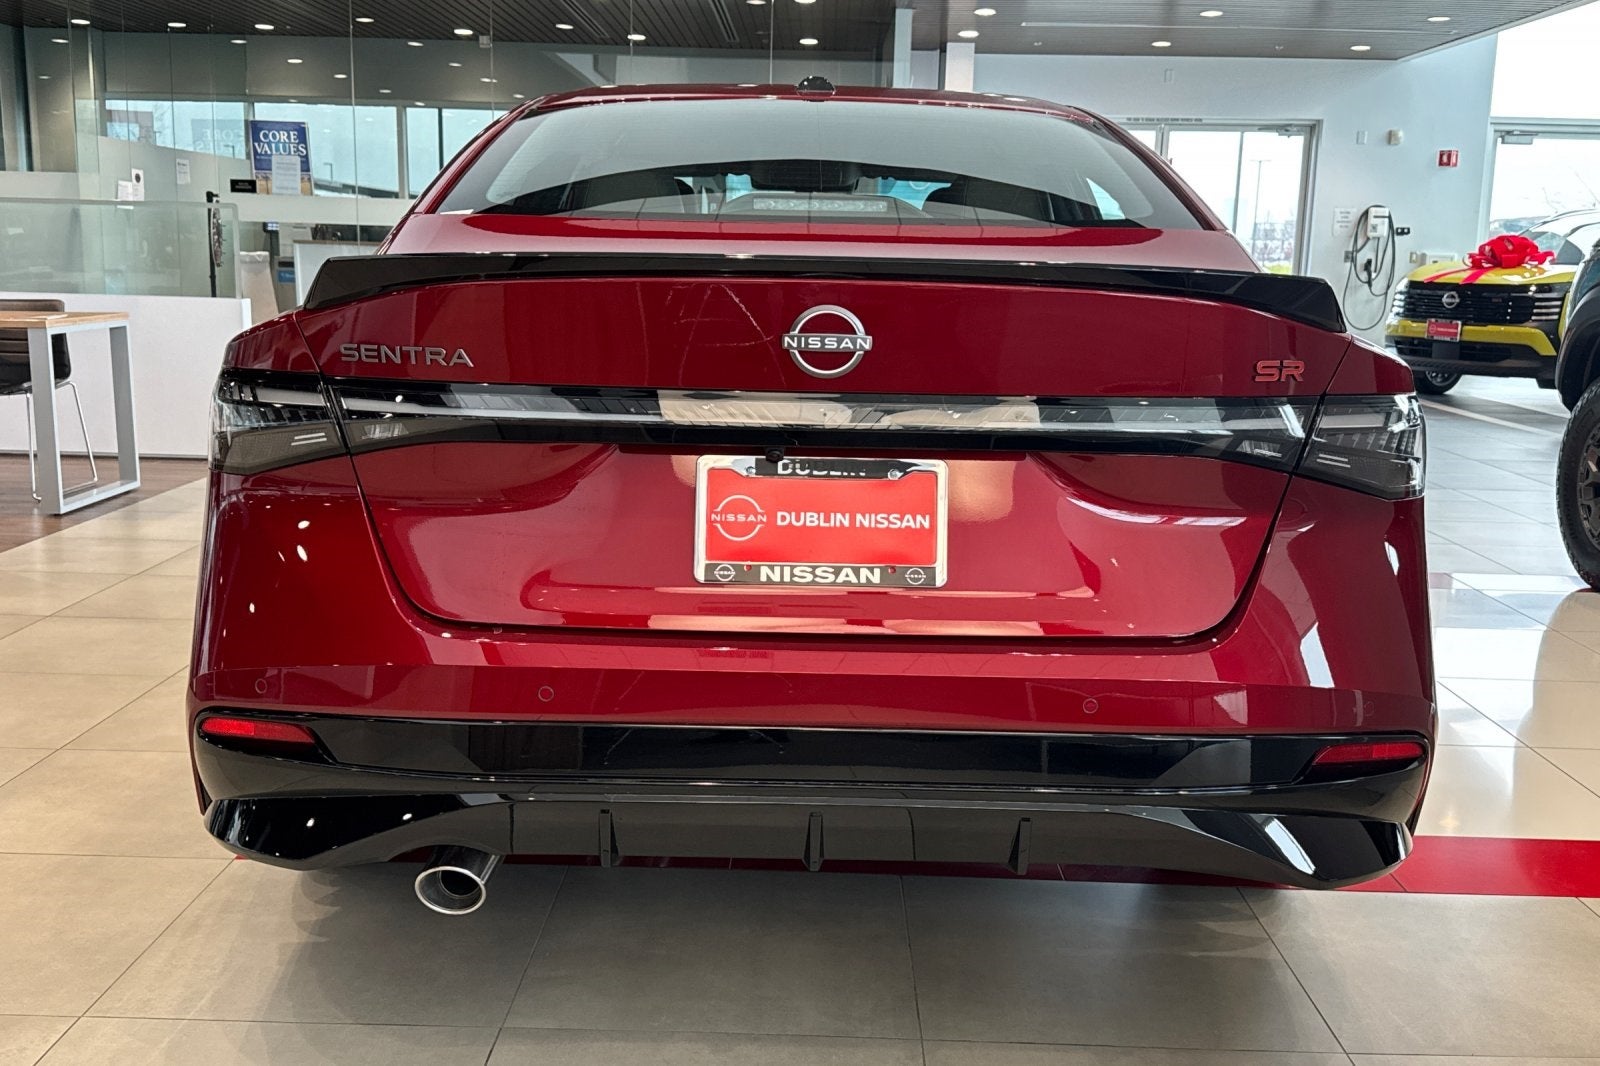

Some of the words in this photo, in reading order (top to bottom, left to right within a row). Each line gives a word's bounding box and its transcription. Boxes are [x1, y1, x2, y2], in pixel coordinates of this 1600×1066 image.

[259, 130, 299, 143] CORE
[254, 142, 307, 156] VALUES
[784, 336, 870, 349] NISSAN
[339, 343, 475, 368] SENTRA
[1254, 360, 1305, 382] SR
[710, 513, 767, 523] NISSAN
[776, 511, 850, 527] DUBLIN
[855, 512, 930, 530] NISSAN
[759, 565, 881, 584] NISSAN
